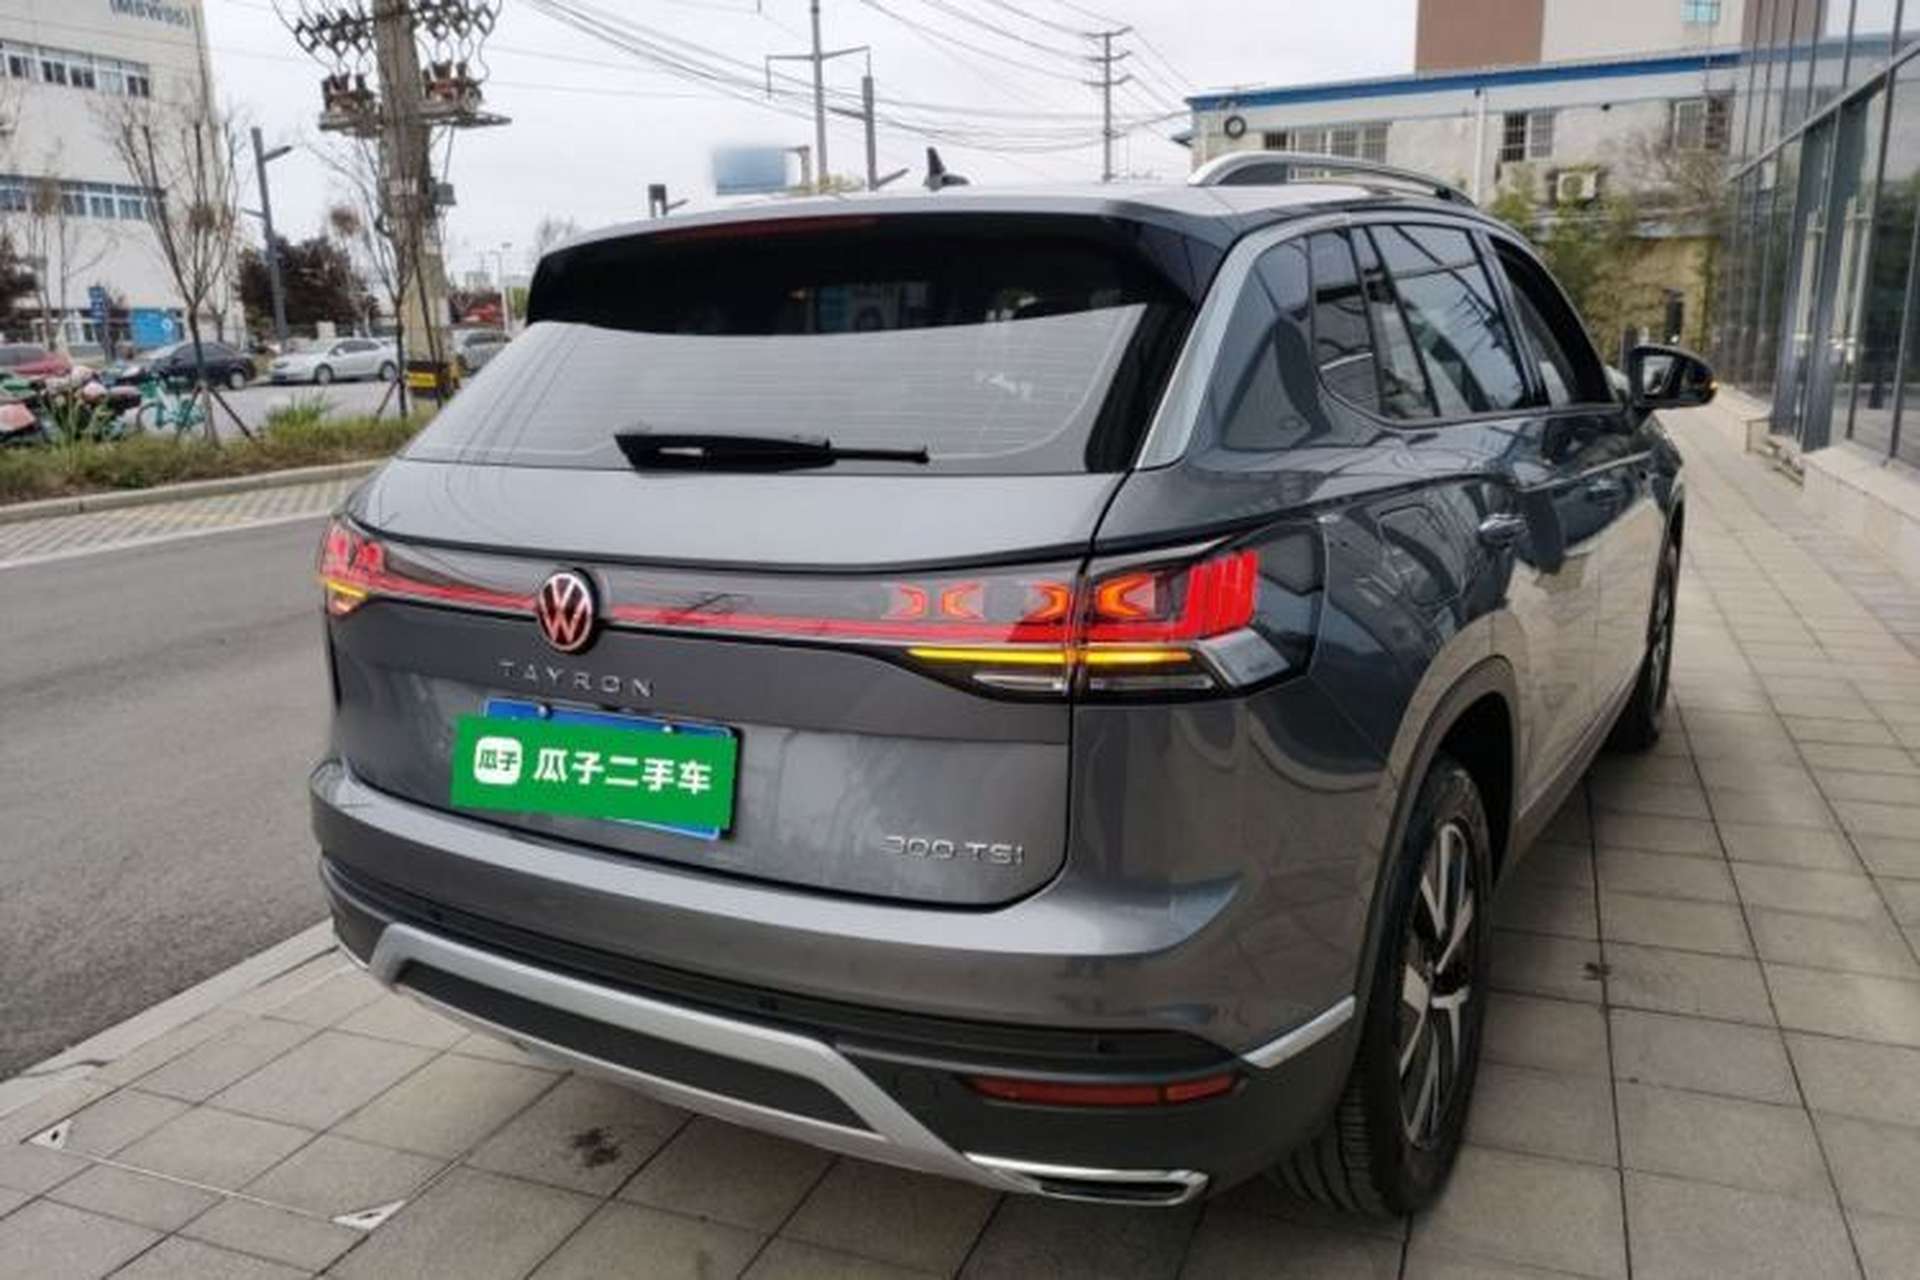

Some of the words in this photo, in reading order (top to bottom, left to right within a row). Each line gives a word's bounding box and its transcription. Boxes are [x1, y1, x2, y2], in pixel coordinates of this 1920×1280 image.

[500, 661, 652, 697] TAYRON
[882, 836, 955, 860] 300
[965, 842, 1024, 864] TSI
